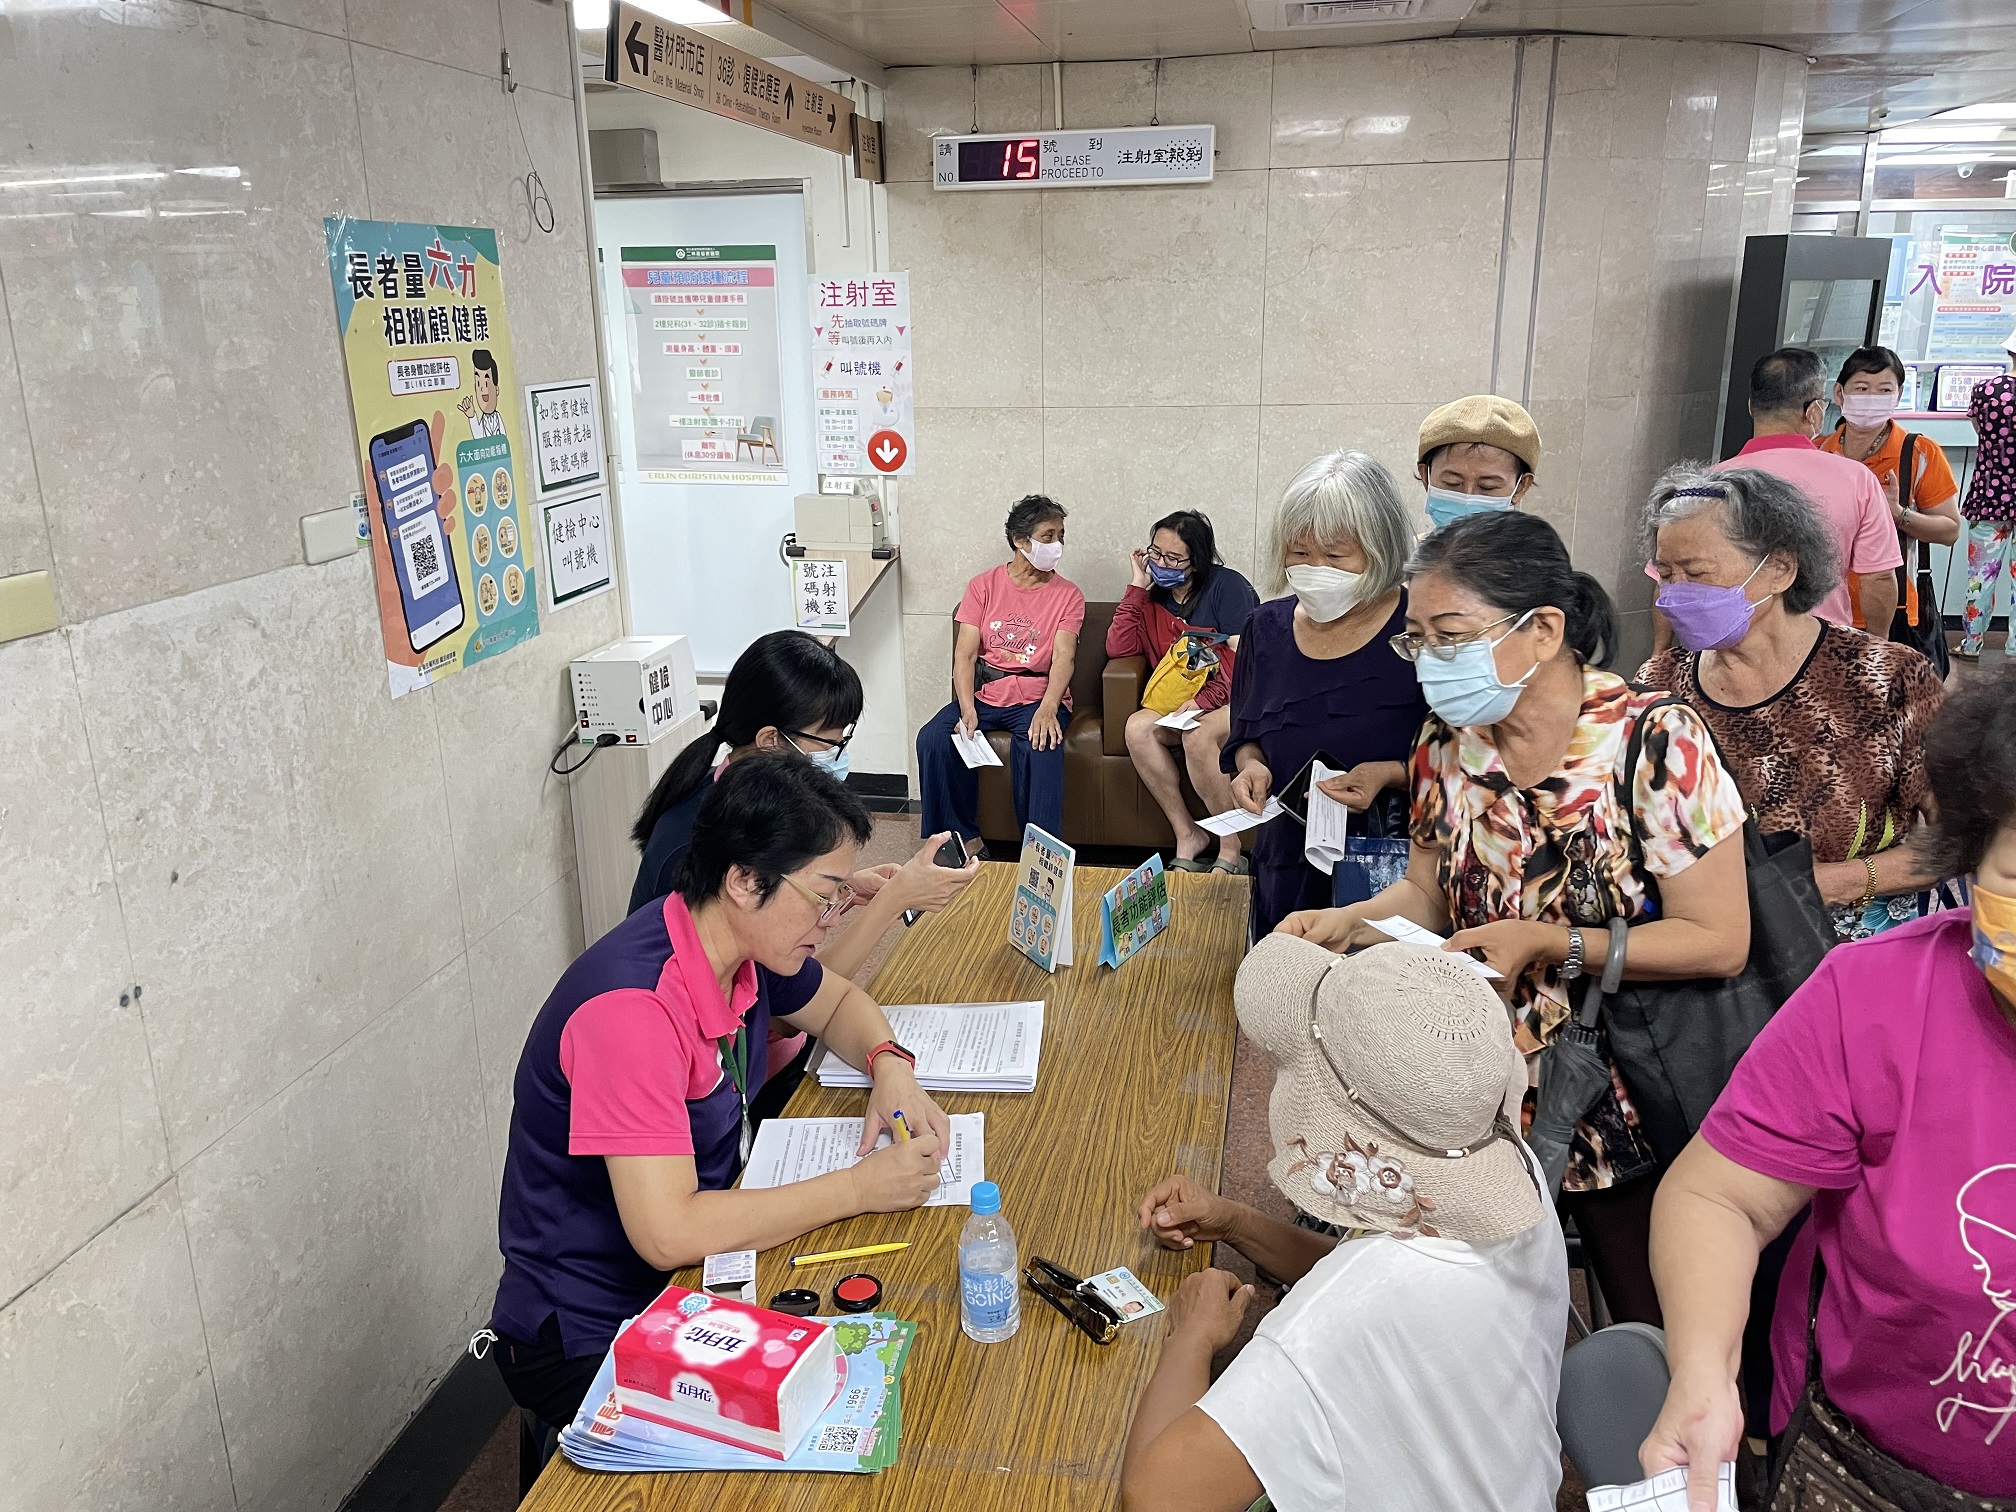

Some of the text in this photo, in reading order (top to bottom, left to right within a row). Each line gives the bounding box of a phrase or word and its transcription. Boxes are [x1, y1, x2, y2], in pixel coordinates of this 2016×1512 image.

[654, 26, 704, 77] 醫材門市店
[939, 138, 1103, 156] 請 號 到
[1001, 141, 1039, 178] 15
[1053, 155, 1091, 166] PLEASE
[938, 172, 957, 182] NO.
[1041, 167, 1104, 179] PROCEED TO
[348, 240, 477, 300] 長者量六力
[647, 270, 749, 285] 兒童預防接種流程
[820, 279, 897, 307] 注射室
[397, 361, 451, 378] 長者身體功能評估
[840, 361, 882, 376] 叫號機
[539, 397, 590, 421] 如您需健檢
[542, 424, 592, 449] 服務請先抽
[550, 450, 590, 474] 取號碼牌
[648, 472, 778, 482] ERLIN CHRISTIAN HOSPITAL
[552, 513, 600, 545] 健檢中心
[562, 543, 599, 574] 叫號機
[802, 562, 821, 615] 號碼機
[821, 563, 838, 615] 注射室
[648, 664, 671, 695] 健檢
[651, 696, 674, 725] 中心
[1112, 880, 1168, 937] 長者功能評估
[966, 1285, 1012, 1306] GOING
[684, 1326, 747, 1352] 五月花
[676, 1381, 713, 1402] 五月花
[845, 1388, 861, 1409] 1966
